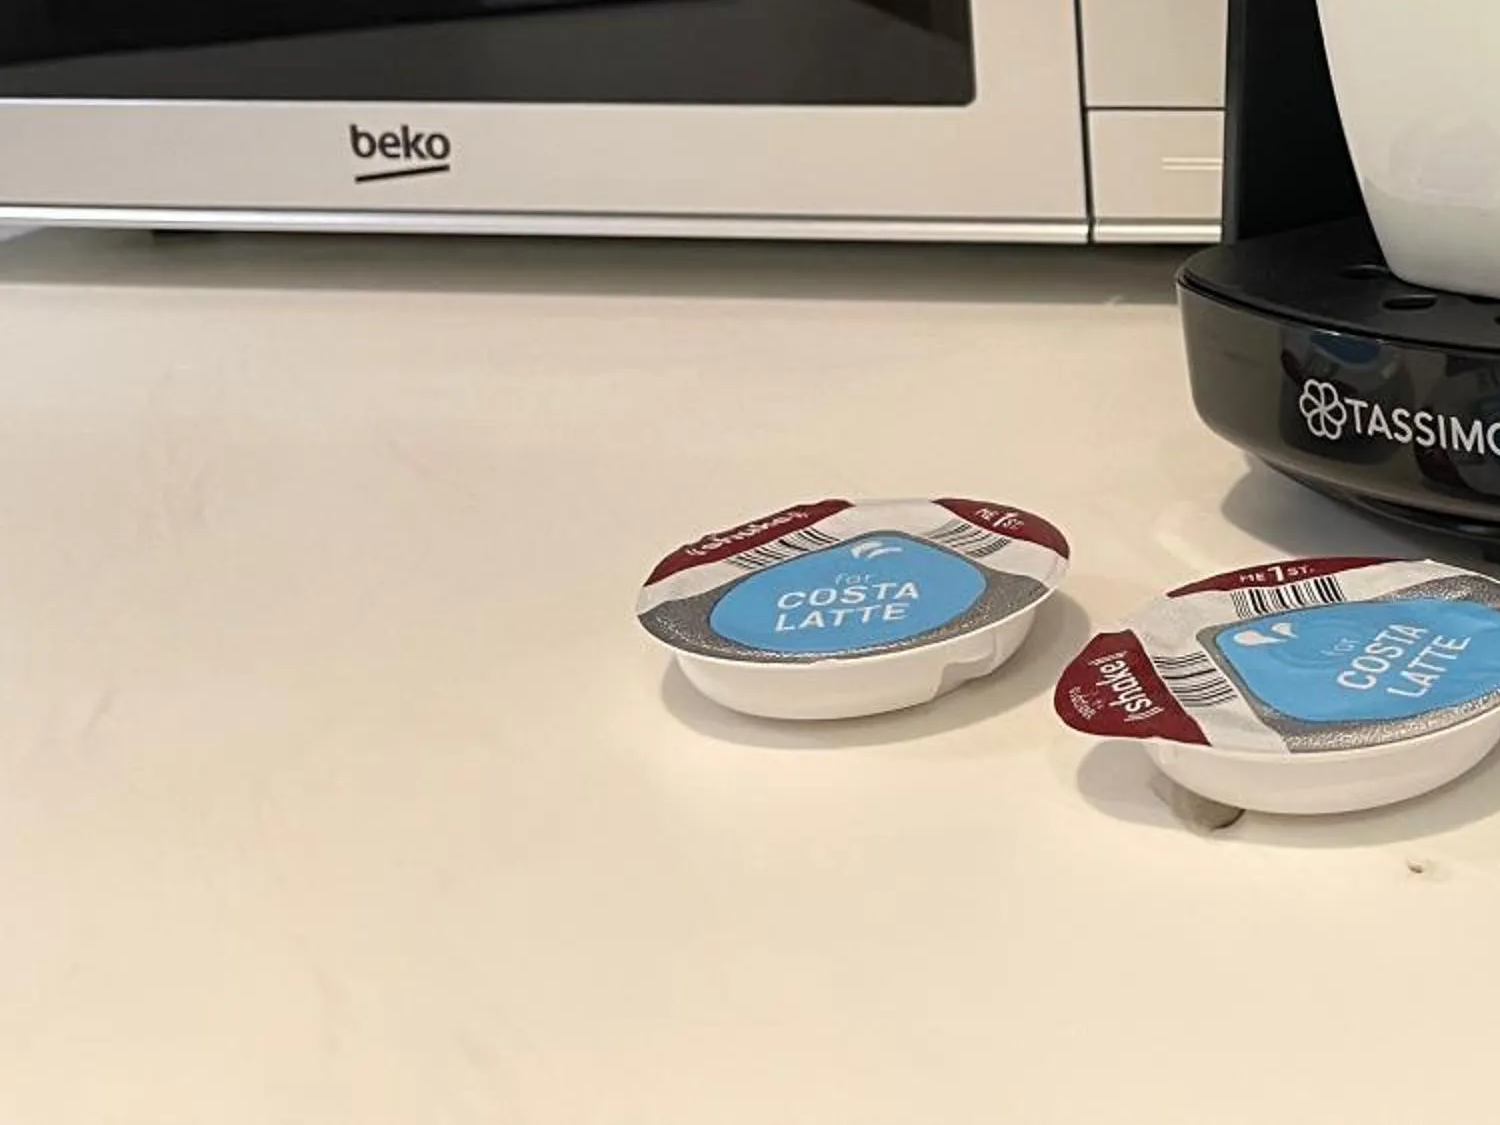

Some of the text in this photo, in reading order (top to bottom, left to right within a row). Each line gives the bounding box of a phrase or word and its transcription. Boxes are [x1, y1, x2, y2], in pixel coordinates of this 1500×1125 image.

[349, 124, 452, 160] beko
[776, 581, 920, 611] COSTA
[774, 602, 911, 633] LATTE
[1336, 624, 1430, 691] COSTA
[1385, 635, 1473, 698] LATTE
